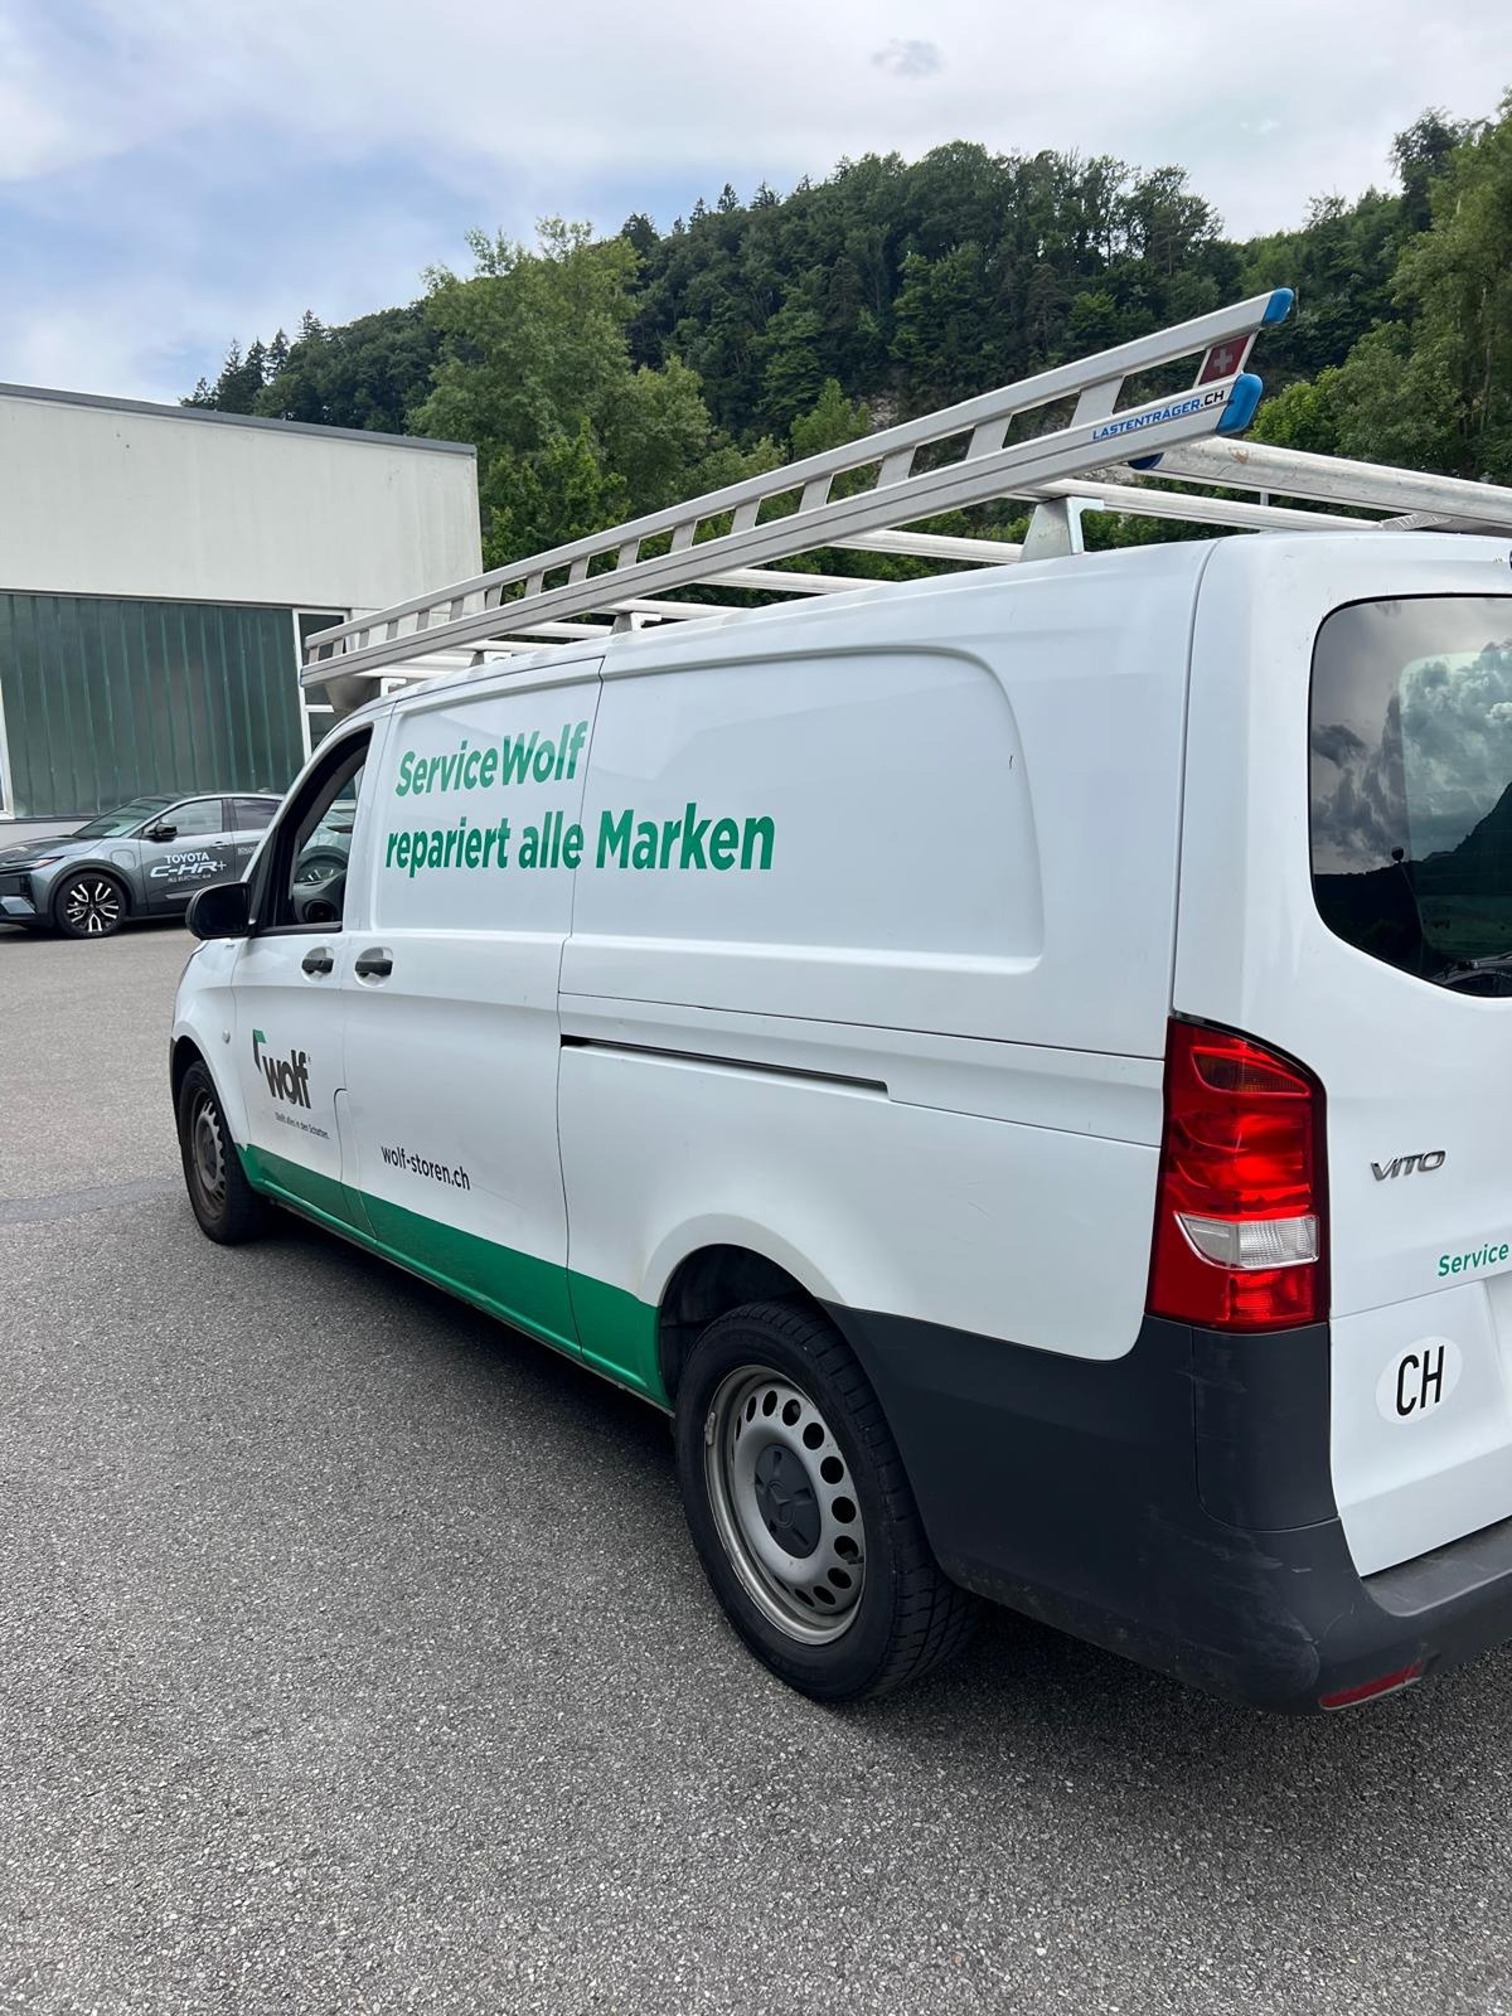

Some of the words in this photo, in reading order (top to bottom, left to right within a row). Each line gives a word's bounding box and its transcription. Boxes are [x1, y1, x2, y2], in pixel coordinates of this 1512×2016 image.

[165, 851, 210, 864] TOYOTA
[385, 816, 511, 878] repariert
[518, 811, 584, 869] alle
[596, 802, 776, 871] Marken
[262, 1049, 311, 1109] wolf
[381, 1146, 471, 1191] wolf-storen.ch
[1370, 1150, 1446, 1181] VITO
[1438, 1243, 1510, 1277] Service
[1396, 1346, 1445, 1416] CH
